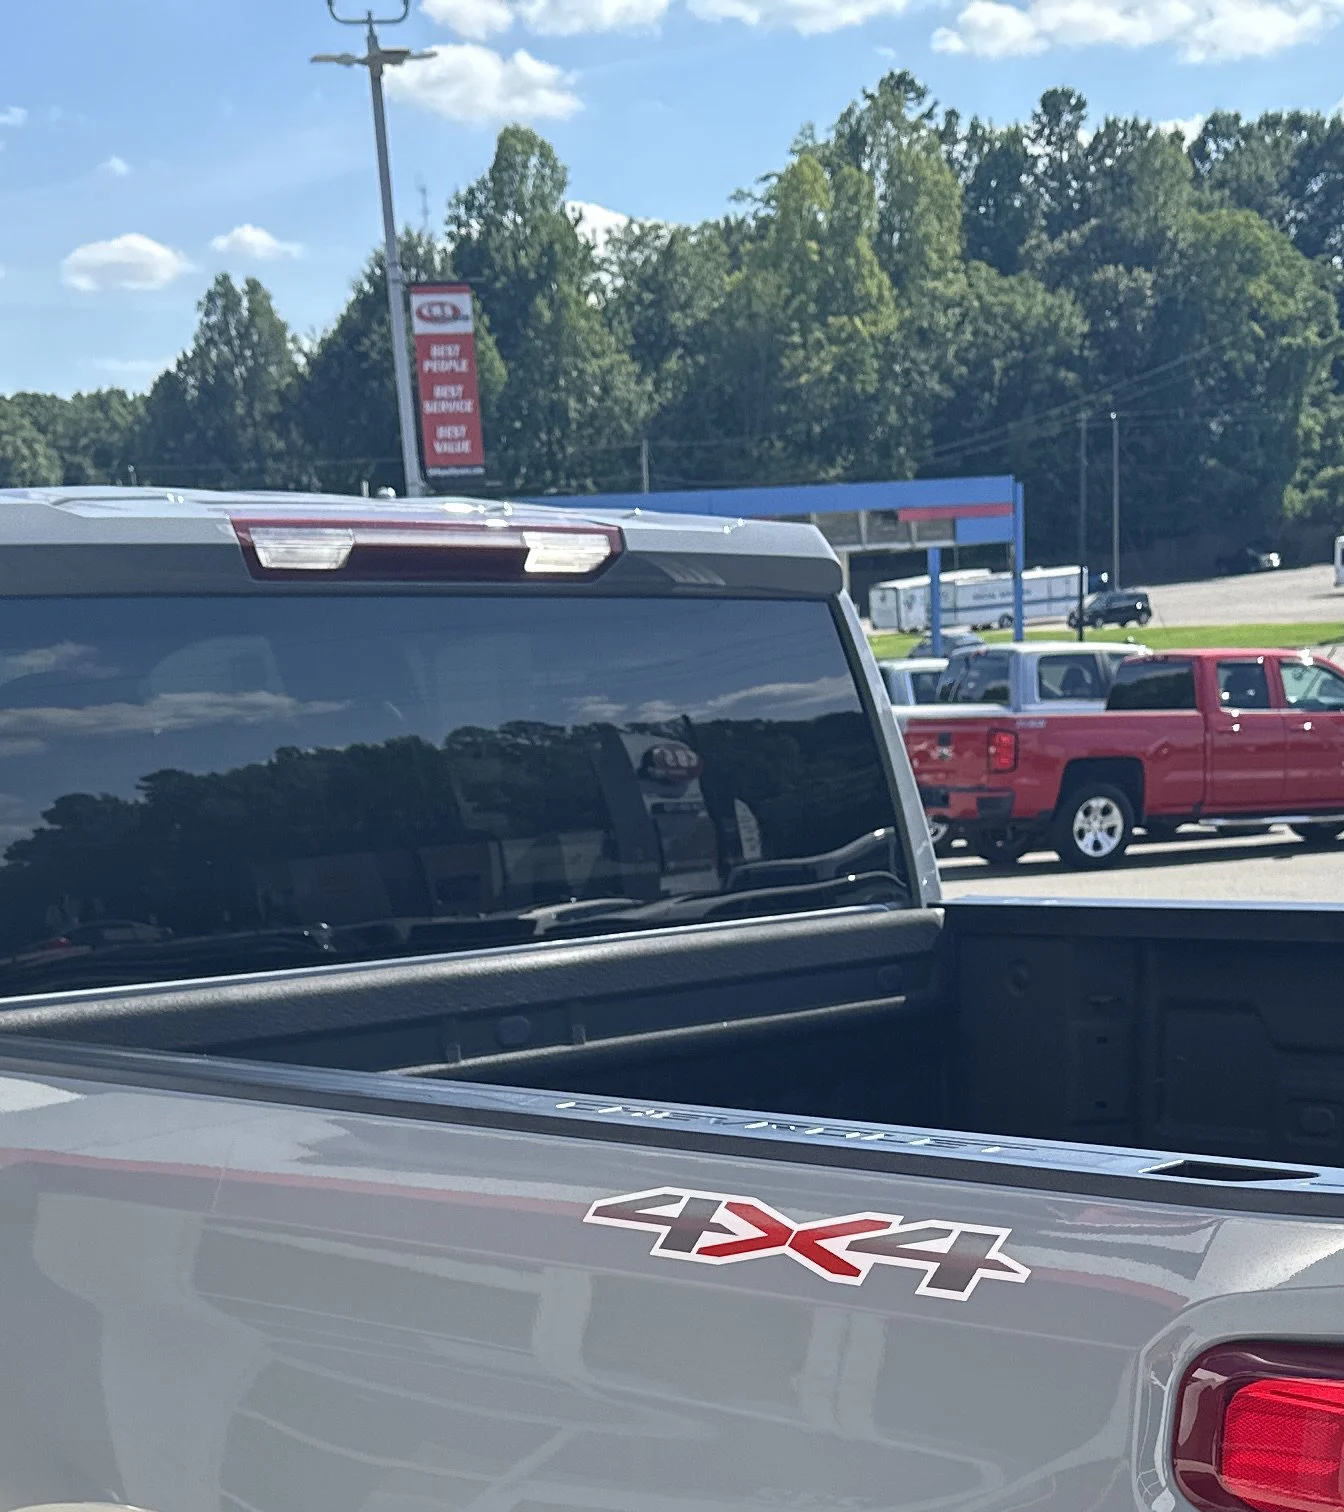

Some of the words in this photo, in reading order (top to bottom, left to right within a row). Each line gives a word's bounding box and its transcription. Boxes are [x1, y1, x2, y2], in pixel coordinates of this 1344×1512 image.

[430, 344, 461, 358] BEST
[423, 359, 469, 373] PEOPLE
[433, 385, 464, 398] BEST
[423, 400, 474, 413] SERVICE
[436, 426, 467, 439] BEST
[433, 440, 472, 453] VALUE
